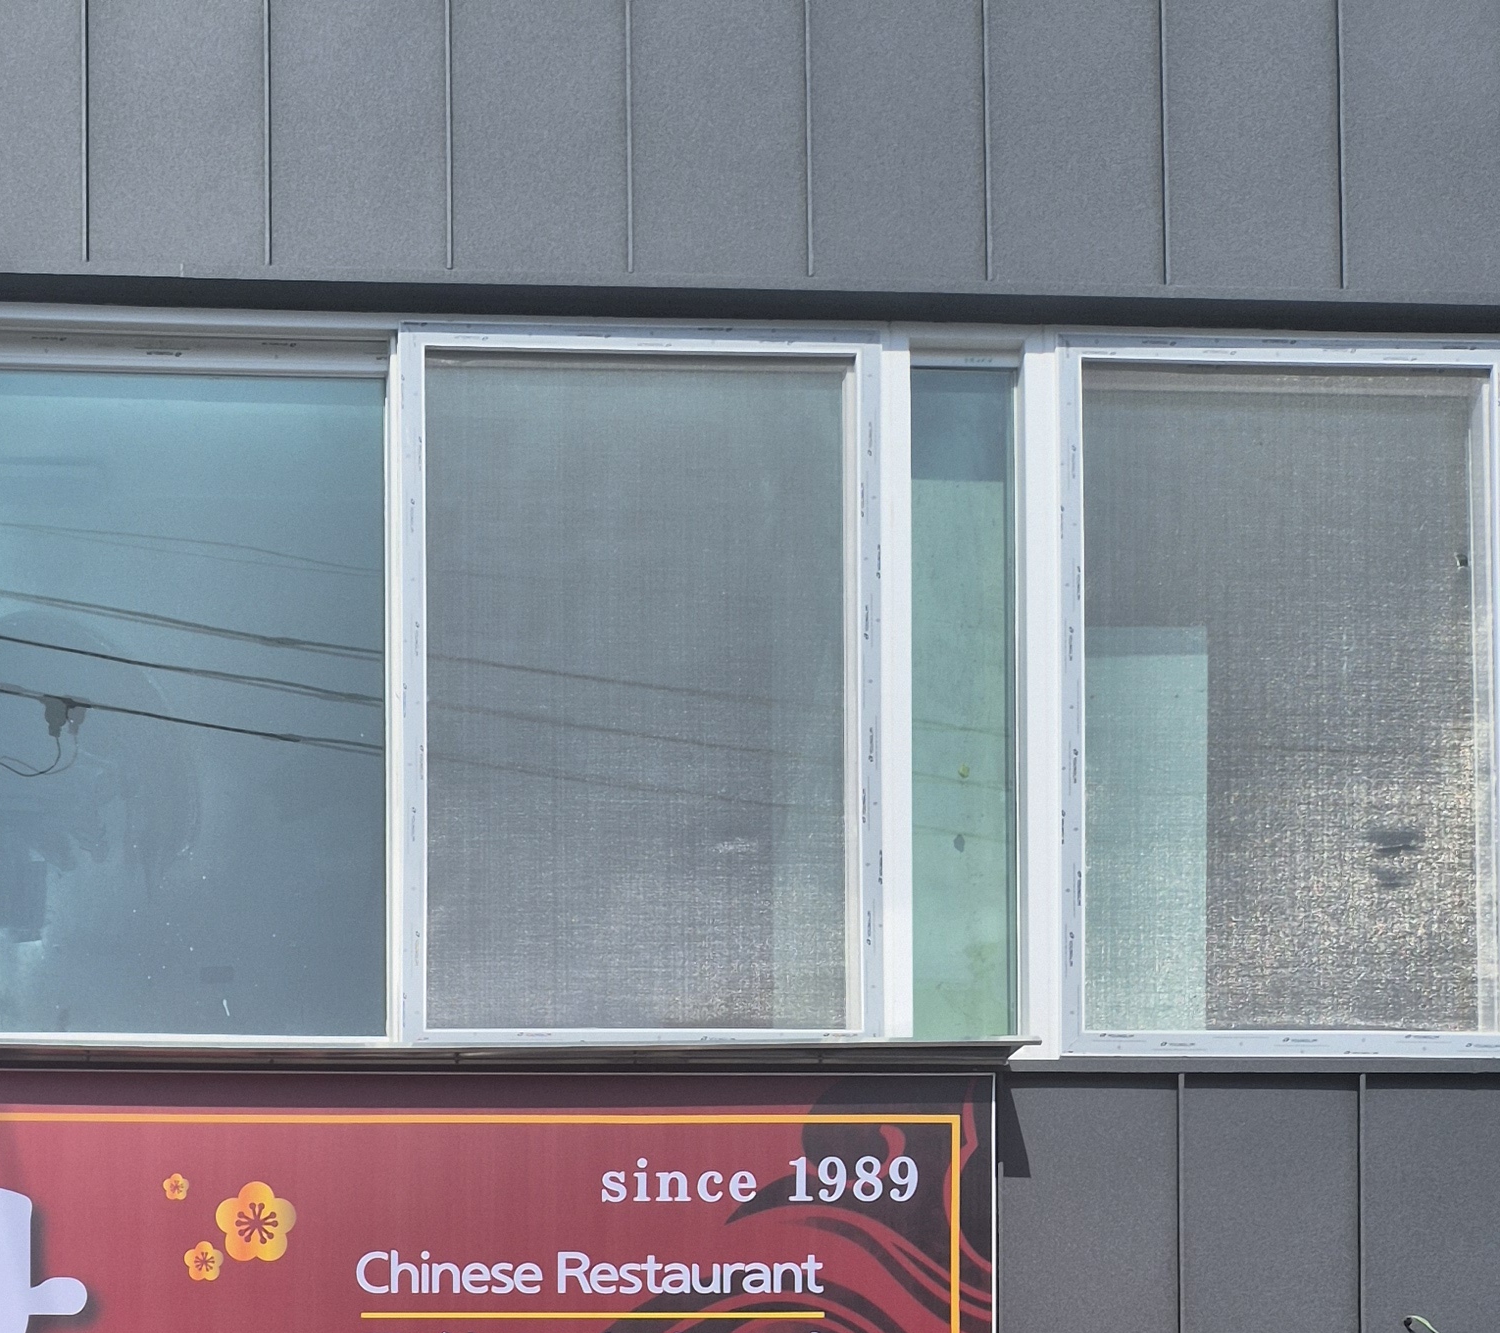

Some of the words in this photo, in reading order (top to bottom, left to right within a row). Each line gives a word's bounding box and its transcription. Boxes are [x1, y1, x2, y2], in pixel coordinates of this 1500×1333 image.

[600, 1157, 759, 1204] since
[787, 1155, 920, 1204] 1989
[355, 1250, 542, 1296] Chinese
[556, 1251, 825, 1296] Restaurant
